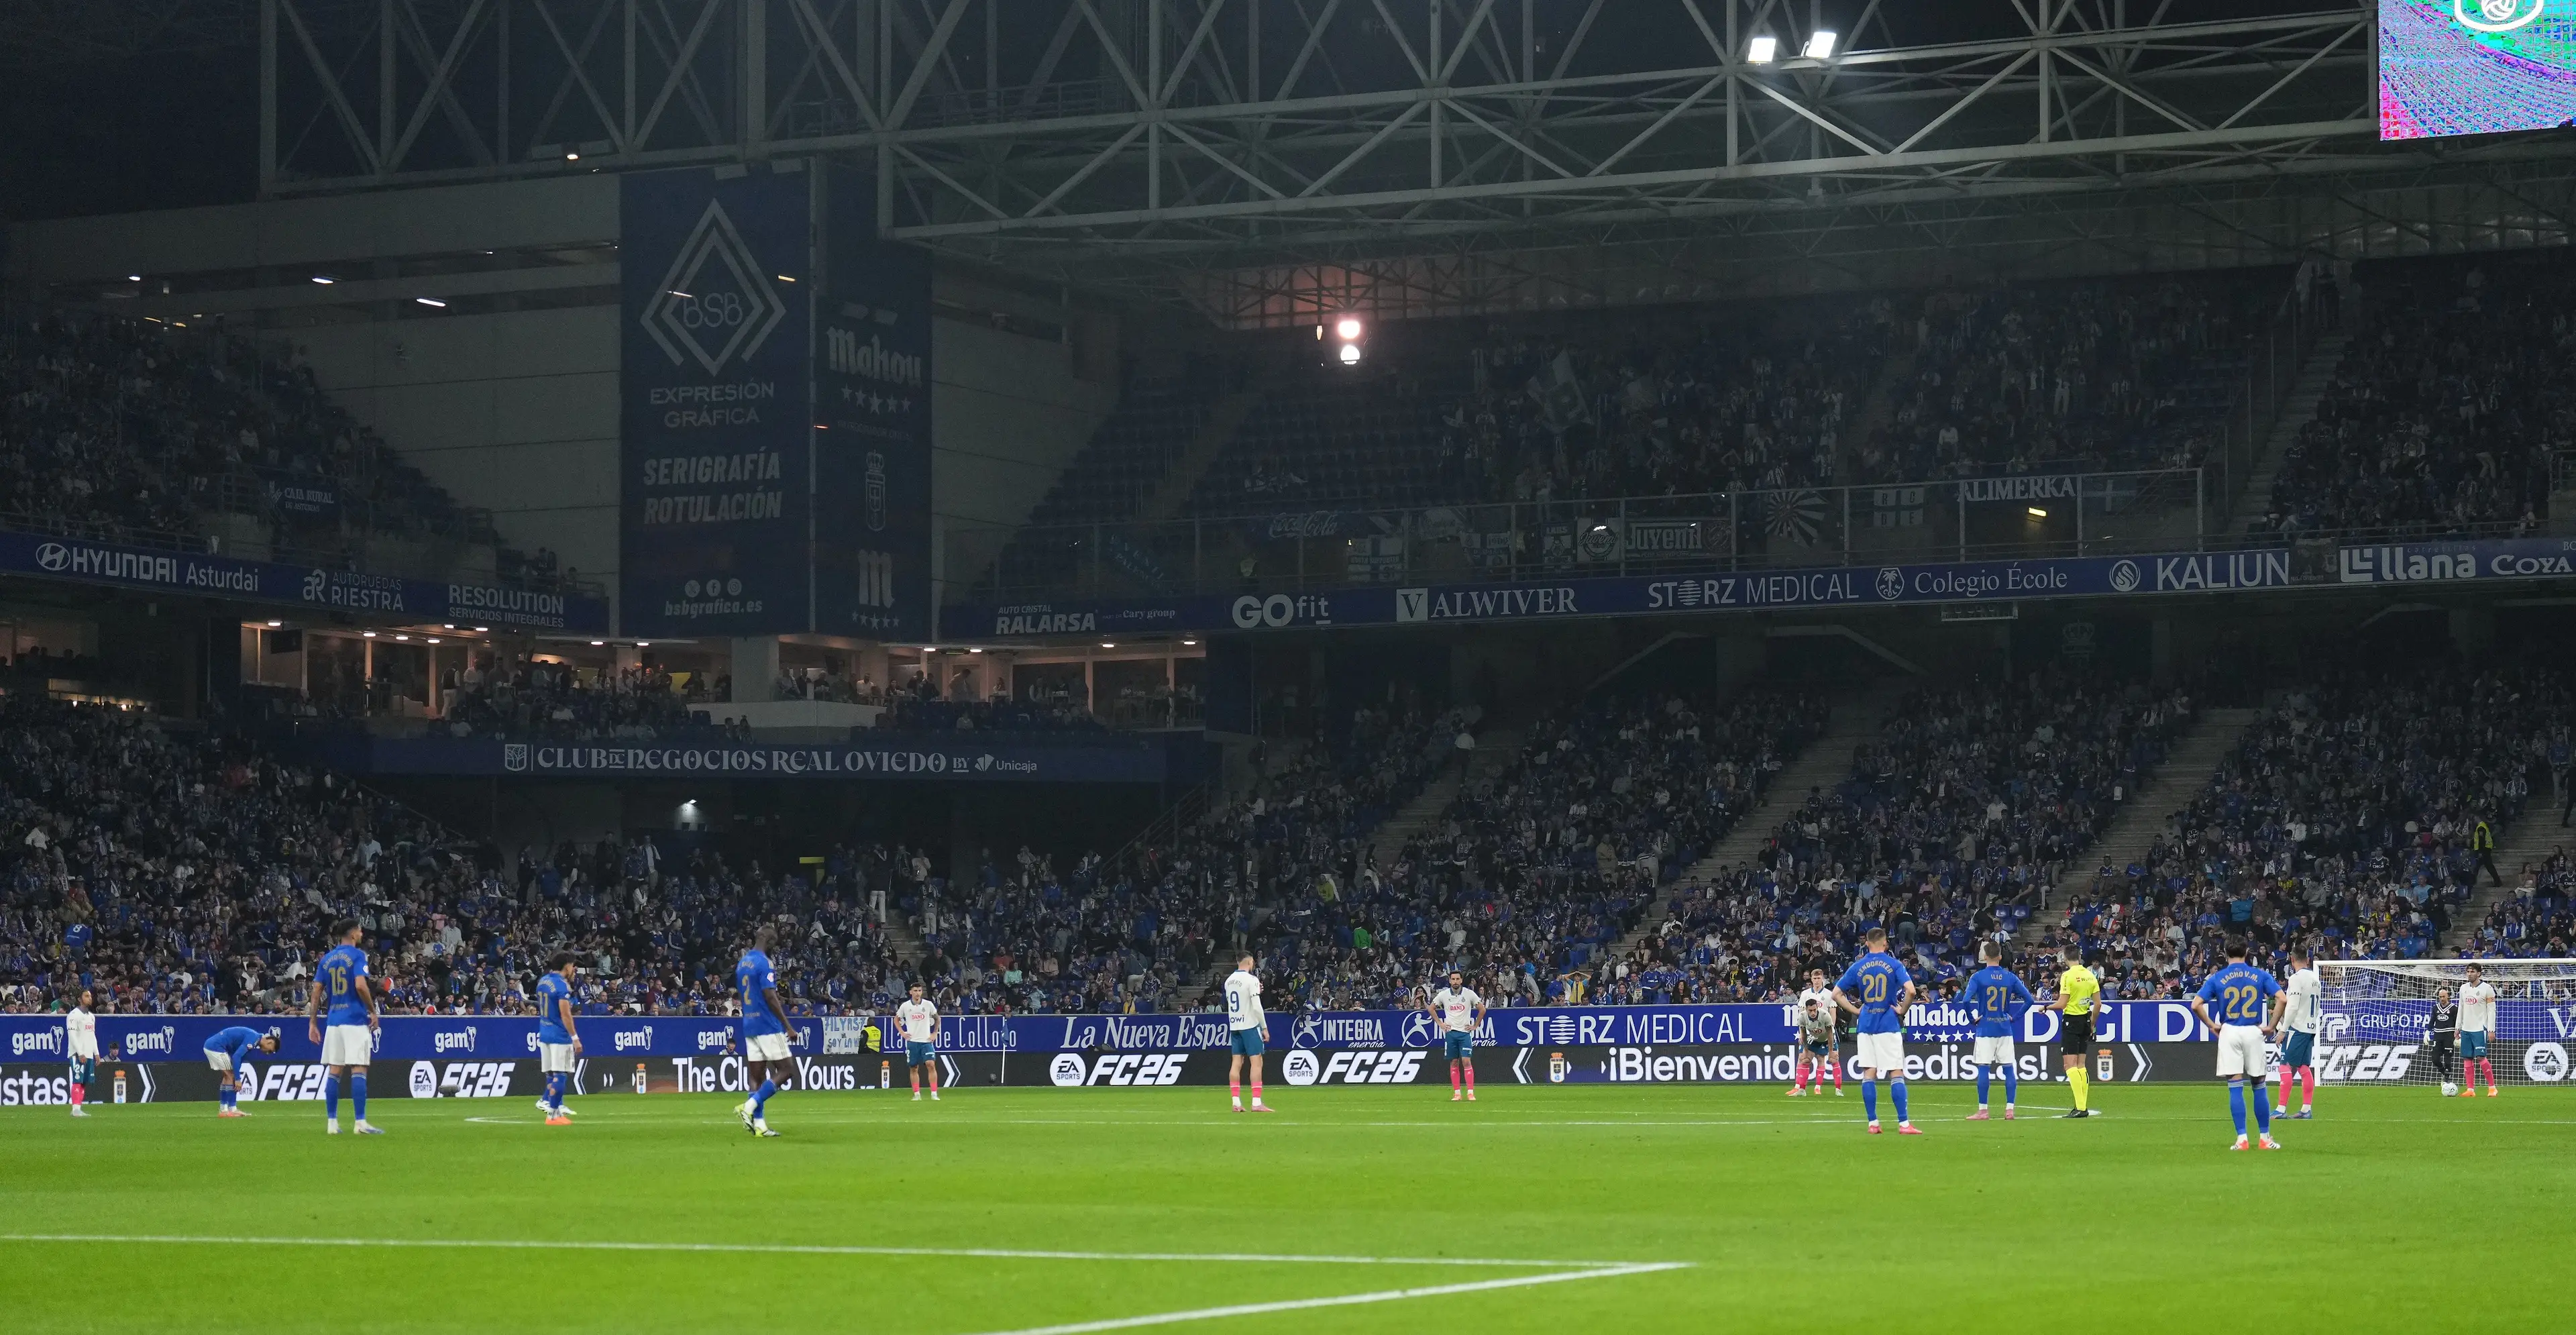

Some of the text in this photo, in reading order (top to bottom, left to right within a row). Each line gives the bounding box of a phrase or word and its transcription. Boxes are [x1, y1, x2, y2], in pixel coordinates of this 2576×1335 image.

[684, 292, 743, 329] BSB
[826, 325, 923, 389] Mahou
[651, 378, 774, 406] EXPRESIÓN
[664, 407, 759, 428] GRÁFICA
[643, 446, 780, 485] SERIGRAFÍA
[1957, 476, 2077, 502] ALIMERKA
[644, 487, 782, 526] ROTULACIÓN
[73, 547, 258, 591] HYUNDAI Asturdai
[2157, 551, 2289, 591] KALIUN
[2381, 547, 2476, 581] llana
[2491, 554, 2574, 575] COYA
[332, 572, 402, 590] AUTORUEDAS
[1746, 572, 1860, 604] MEDICAL
[1915, 562, 2068, 597] Colegio École
[331, 586, 404, 612] RIESTRA
[449, 584, 564, 615] RESOLUTION
[665, 598, 762, 618] bsbgrafica.es
[998, 604, 1052, 615] AUTO CRISTAL
[1431, 588, 1578, 619] ALWIVER
[449, 607, 564, 628] SERVICIOS INTEGRALES
[996, 613, 1096, 635] RALARSA
[1123, 609, 1146, 620] Cary
[1147, 608, 1176, 620] group
[538, 747, 606, 769] CLUB
[628, 748, 766, 771] NEGOCIOS
[773, 751, 839, 774] REAL
[845, 751, 947, 773] OVIEDO
[953, 757, 971, 771] BY
[997, 759, 1038, 773] Unicaja
[329, 967, 348, 996] 16
[742, 974, 751, 1005] 2
[1862, 973, 1888, 1003] 20
[2220, 971, 2243, 985] NACHO
[1230, 991, 1240, 1013] 9
[1986, 986, 2007, 1012] 21
[2224, 985, 2258, 1018] 22
[1230, 1014, 1244, 1023] owi
[1627, 1013, 1752, 1044] MEDICAL
[1905, 1004, 1979, 1027] Maho
[2024, 1004, 2131, 1043] DGI
[2360, 1014, 2430, 1028] GRUPO PA
[12, 1030, 53, 1055] gam
[435, 1031, 468, 1053] gam
[614, 1032, 645, 1051] gam
[698, 1032, 728, 1051] gam
[1061, 1015, 1230, 1051] La Nueva Espa
[1323, 1018, 1384, 1041] INTEGRA
[126, 1031, 166, 1055] gam
[1348, 1040, 1386, 1049] energía
[1057, 1061, 1078, 1073] EA
[1086, 1054, 1189, 1085] FC26
[1290, 1057, 1312, 1070] EA
[1319, 1052, 1428, 1084] FC26
[2534, 1051, 2560, 1065] EA
[415, 1069, 431, 1083] EA
[437, 1062, 516, 1098] FC26
[672, 1057, 716, 1093] The
[796, 1055, 855, 1090] Yours
